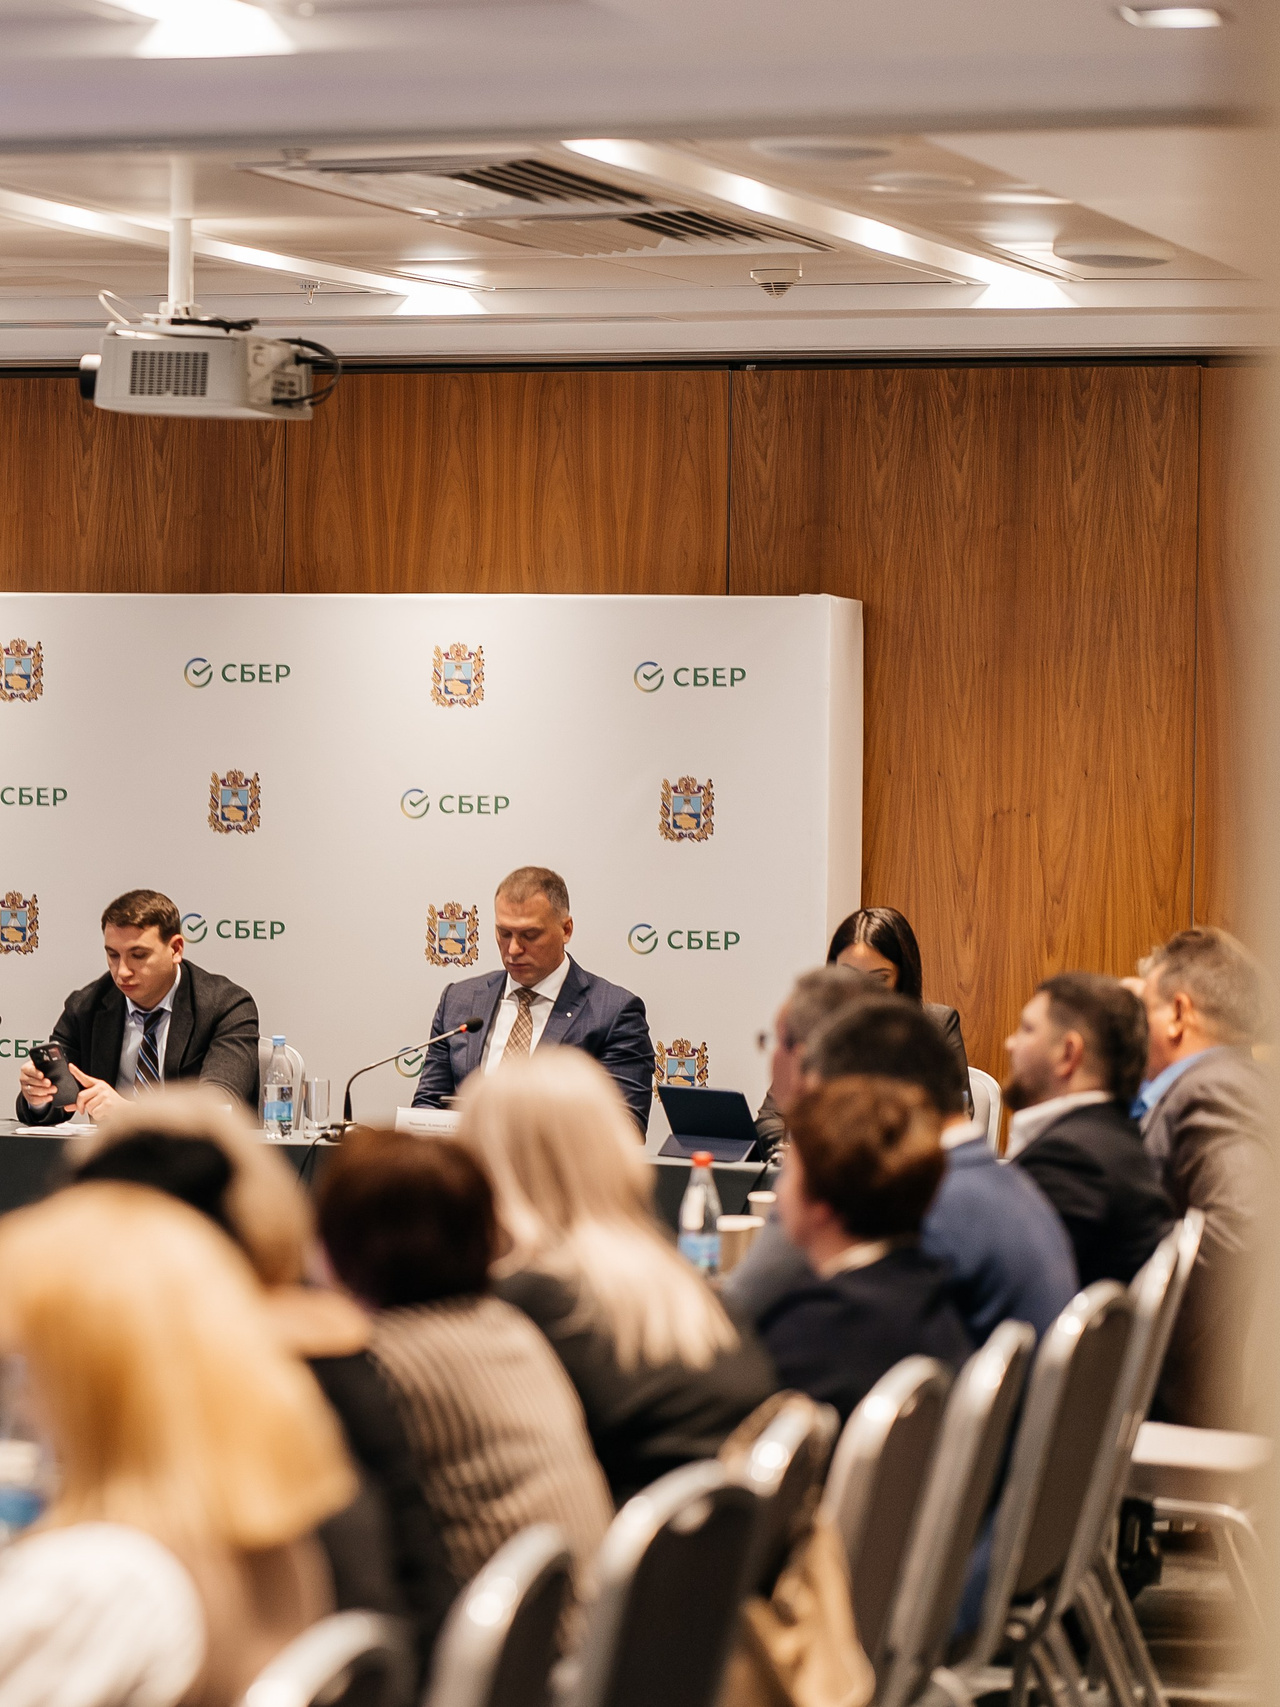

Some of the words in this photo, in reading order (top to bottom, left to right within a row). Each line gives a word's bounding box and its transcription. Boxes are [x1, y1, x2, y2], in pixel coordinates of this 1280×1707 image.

[221, 663, 291, 683] СБЕР
[672, 667, 747, 688] СБЕР
[0, 786, 68, 807] СБЕР
[439, 794, 510, 815] СБЕР
[215, 919, 287, 940] СБЕР
[667, 929, 741, 951] СБЕР
